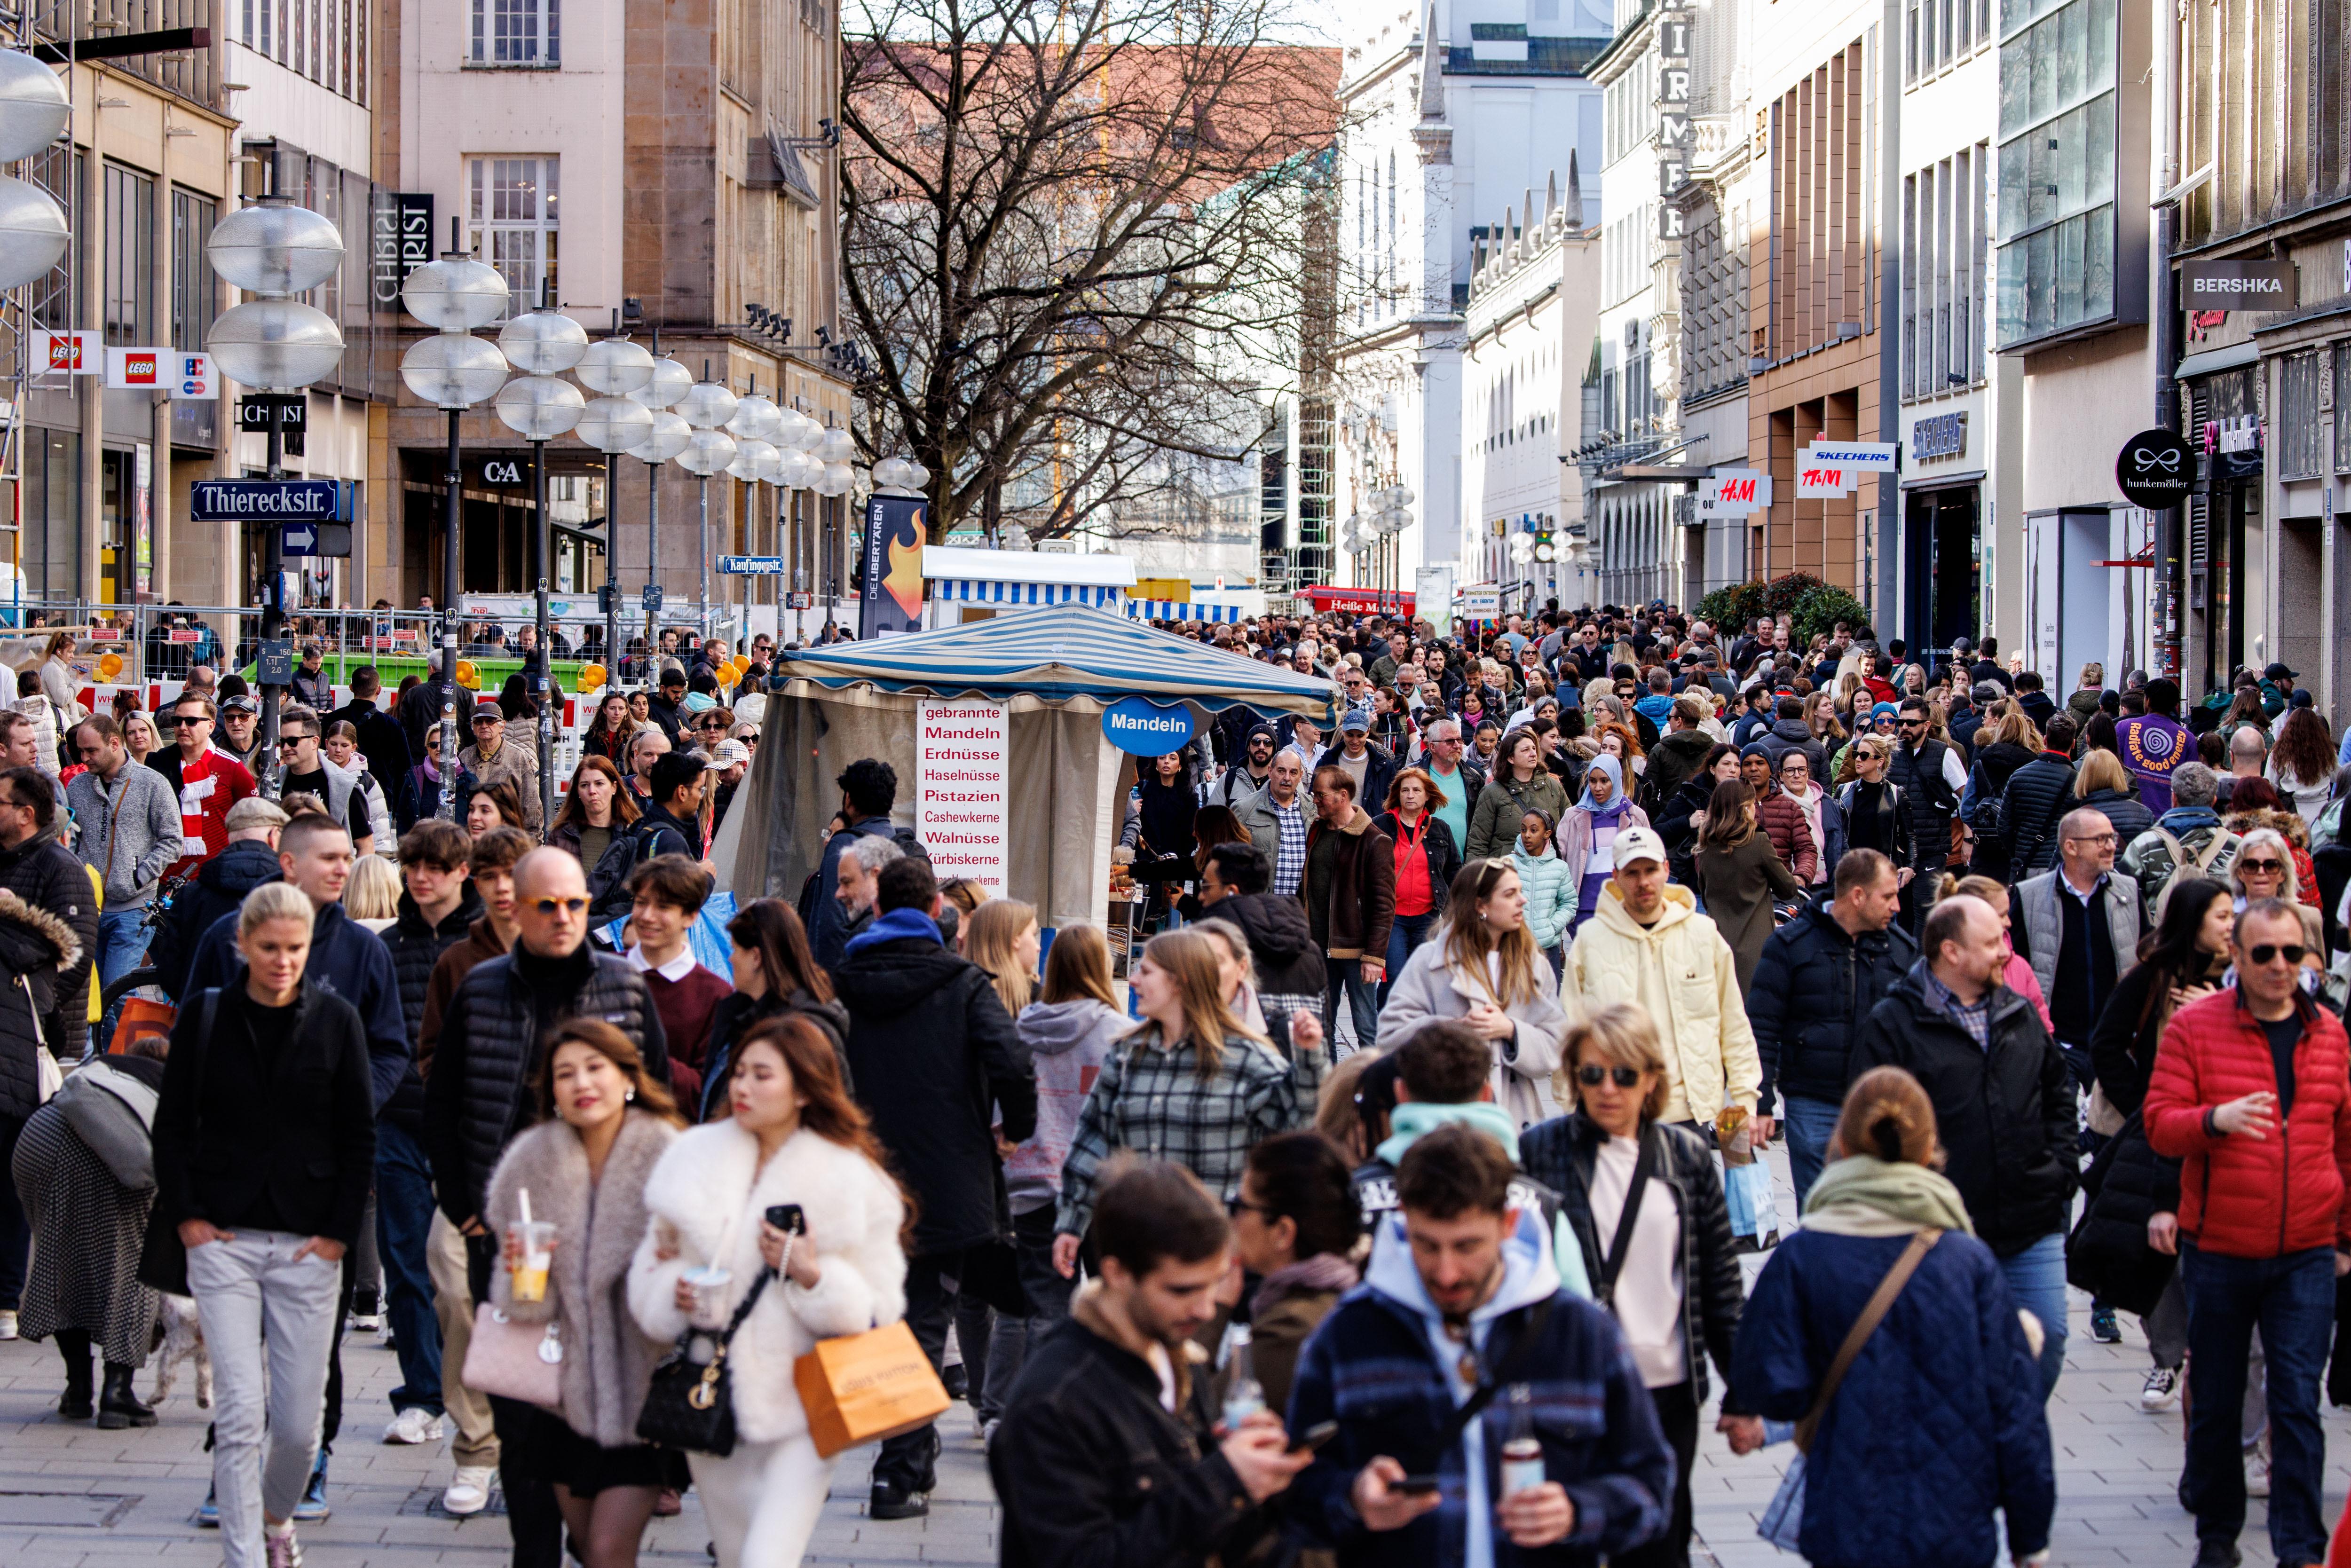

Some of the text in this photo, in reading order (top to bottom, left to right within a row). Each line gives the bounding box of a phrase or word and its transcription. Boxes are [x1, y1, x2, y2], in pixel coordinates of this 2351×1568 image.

[2193, 278, 2282, 292] BERSHKA
[127, 362, 153, 374] LEGO
[245, 405, 302, 422] CHIST
[1913, 410, 1962, 459] SKECHERS
[1815, 452, 1890, 461] SKECHERS
[485, 462, 521, 482] C&A
[1720, 479, 1756, 503] H&M
[202, 487, 324, 512] Thiereckstr.
[870, 504, 883, 582] LIBERTÄREN
[1331, 600, 1363, 611] Heiße
[926, 707, 1000, 720] gebrannte
[1112, 714, 1185, 733] Mandeln
[926, 727, 1000, 739] Mandeln
[2129, 722, 2186, 771] Radiate good energy
[925, 748, 1000, 760] Erdnüsse
[925, 769, 1000, 781] Haselnüsse
[925, 790, 1000, 802] Pistazien
[925, 811, 999, 822] Cashewkerne
[925, 832, 999, 843] Walnüsse
